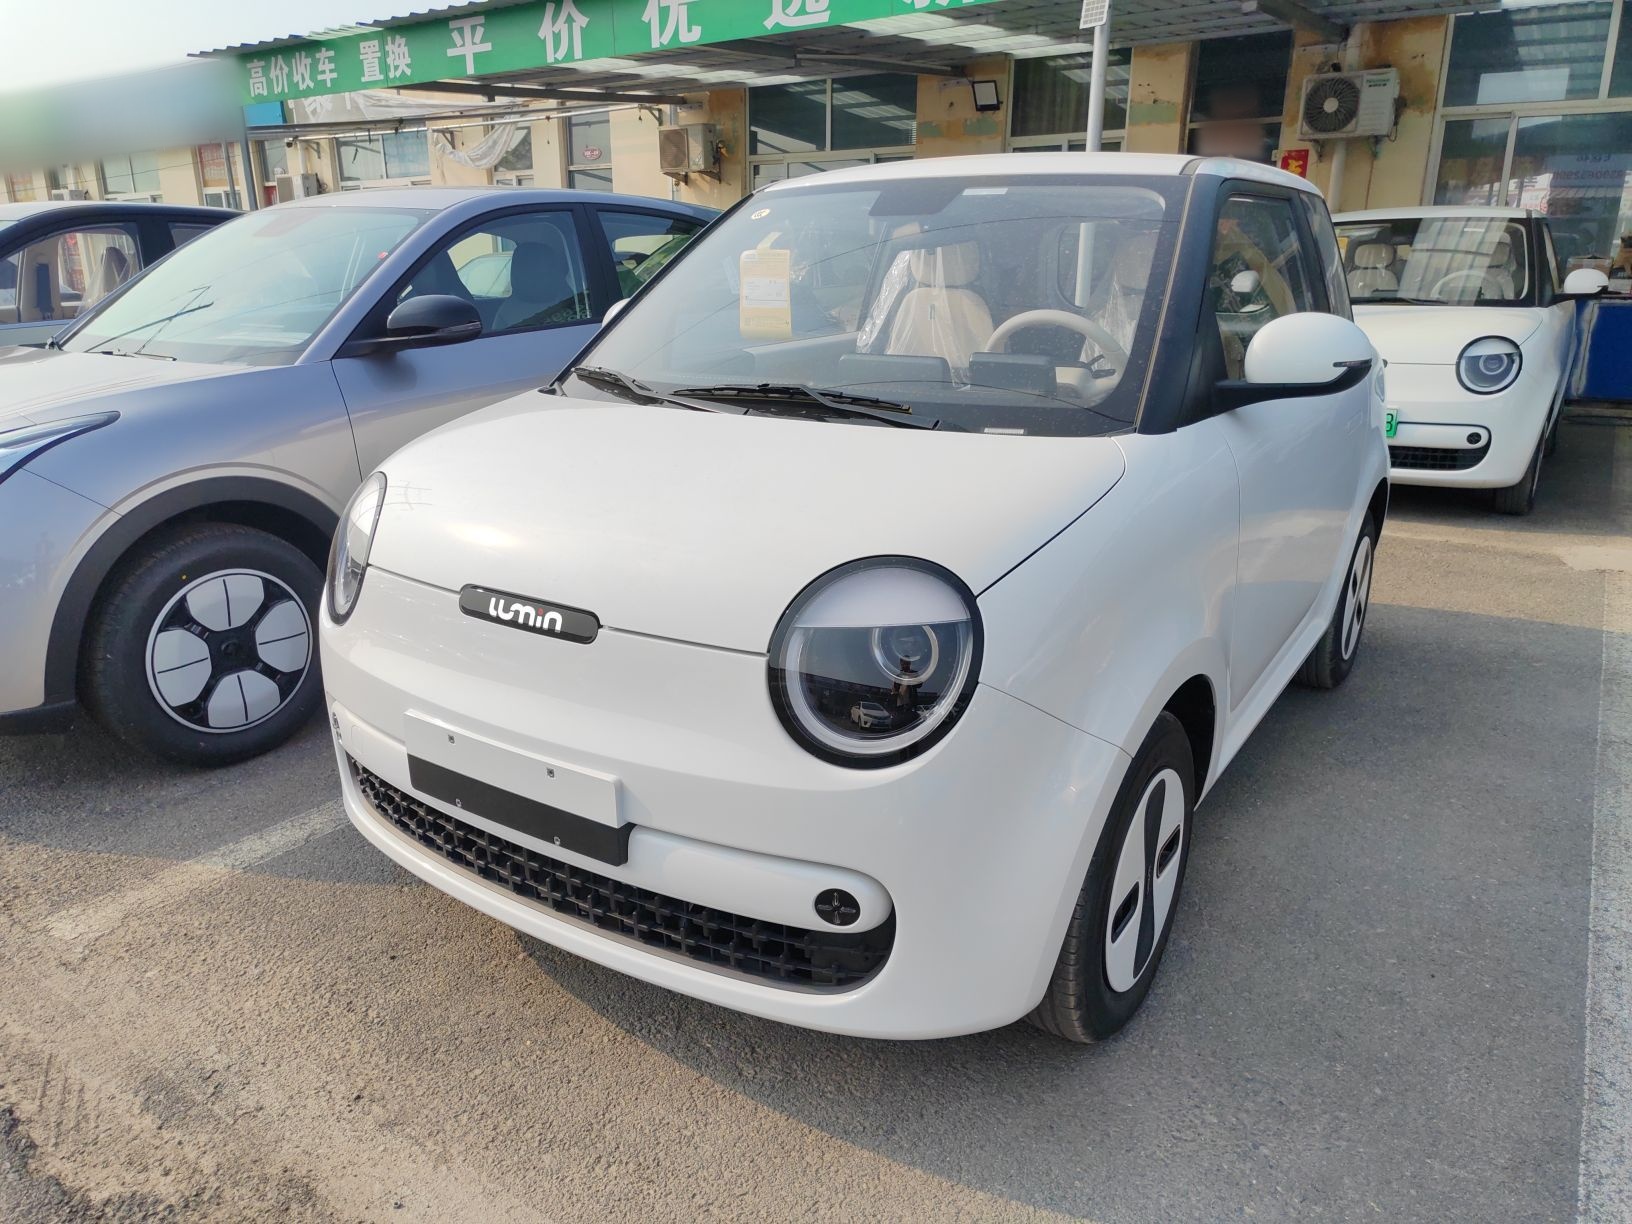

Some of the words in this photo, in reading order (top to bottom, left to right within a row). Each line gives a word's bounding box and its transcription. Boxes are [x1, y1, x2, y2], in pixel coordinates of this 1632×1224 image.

[247, 47, 337, 97] 高价收车
[359, 35, 412, 82] 置换
